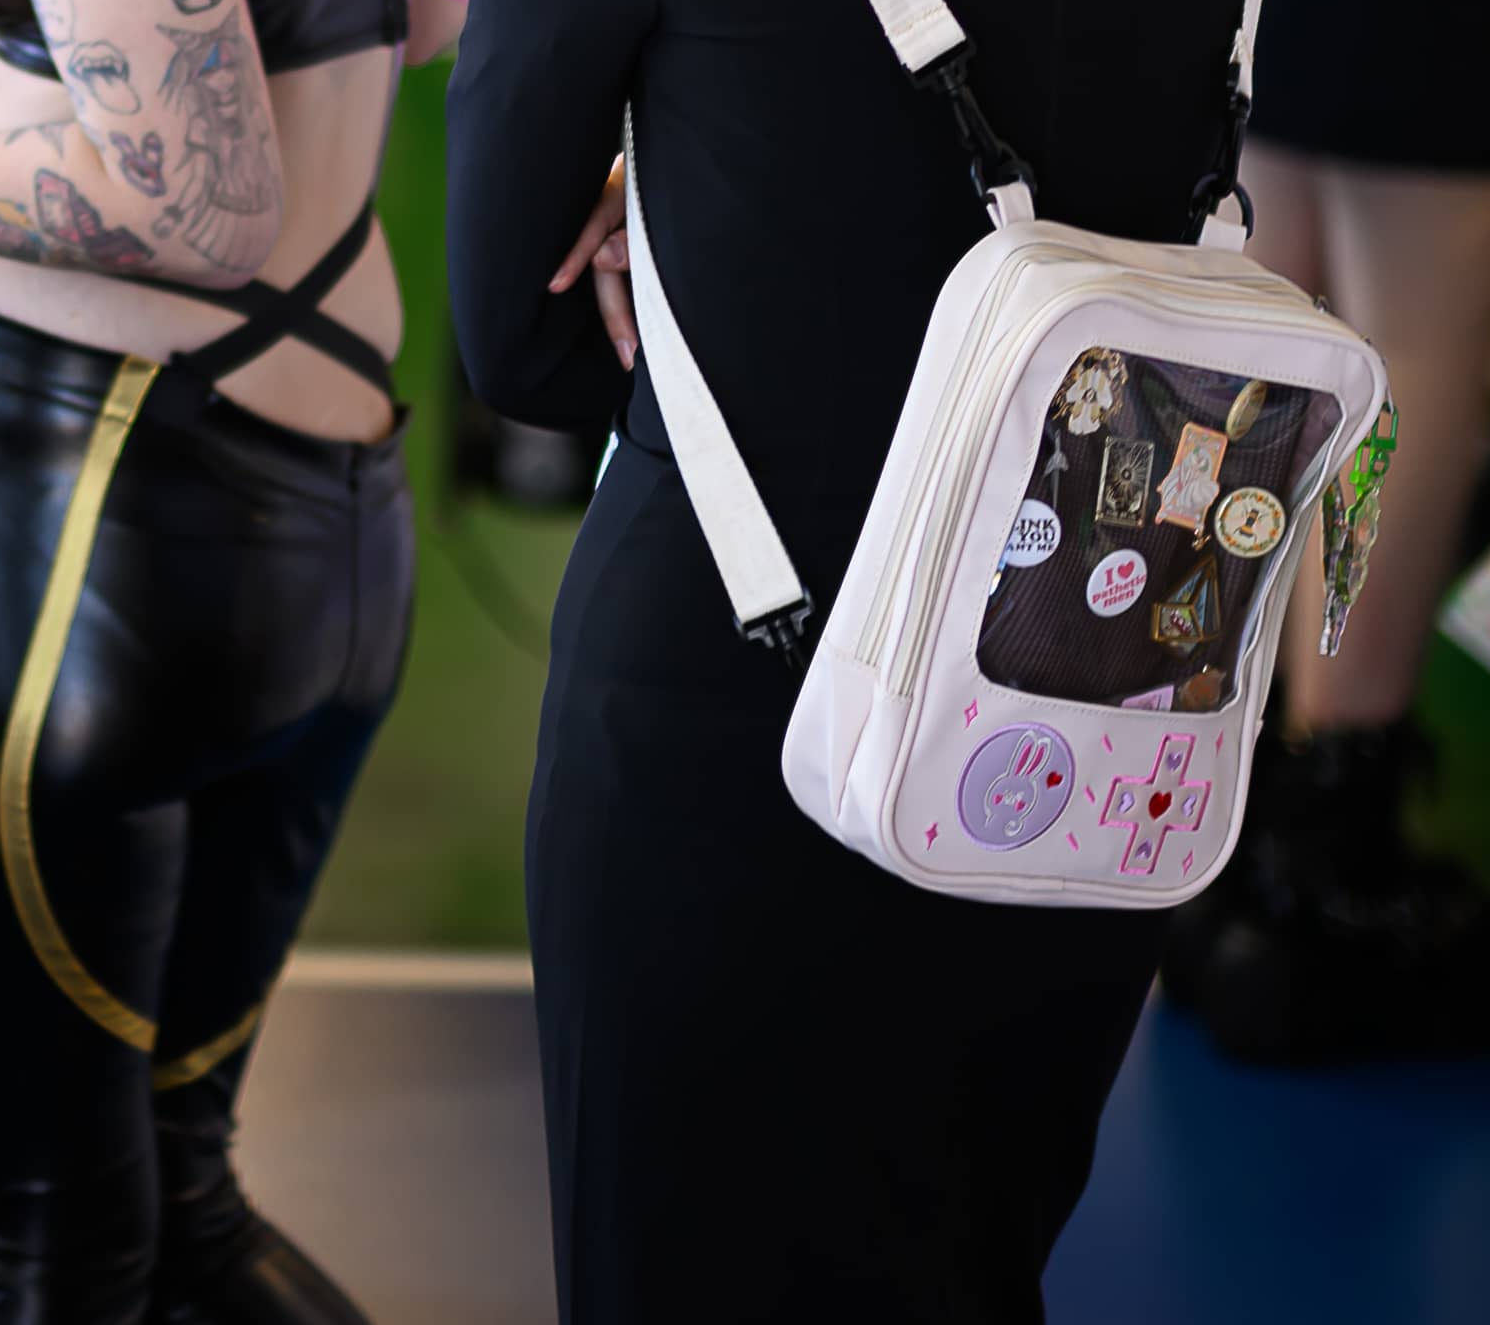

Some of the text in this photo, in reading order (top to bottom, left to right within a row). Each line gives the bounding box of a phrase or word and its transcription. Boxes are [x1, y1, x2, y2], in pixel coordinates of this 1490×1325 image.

[1016, 518, 1054, 533] INK
[1019, 525, 1056, 542] YOU
[1105, 567, 1115, 587] I
[1092, 573, 1147, 605] pathetic
[1103, 588, 1135, 608] men
